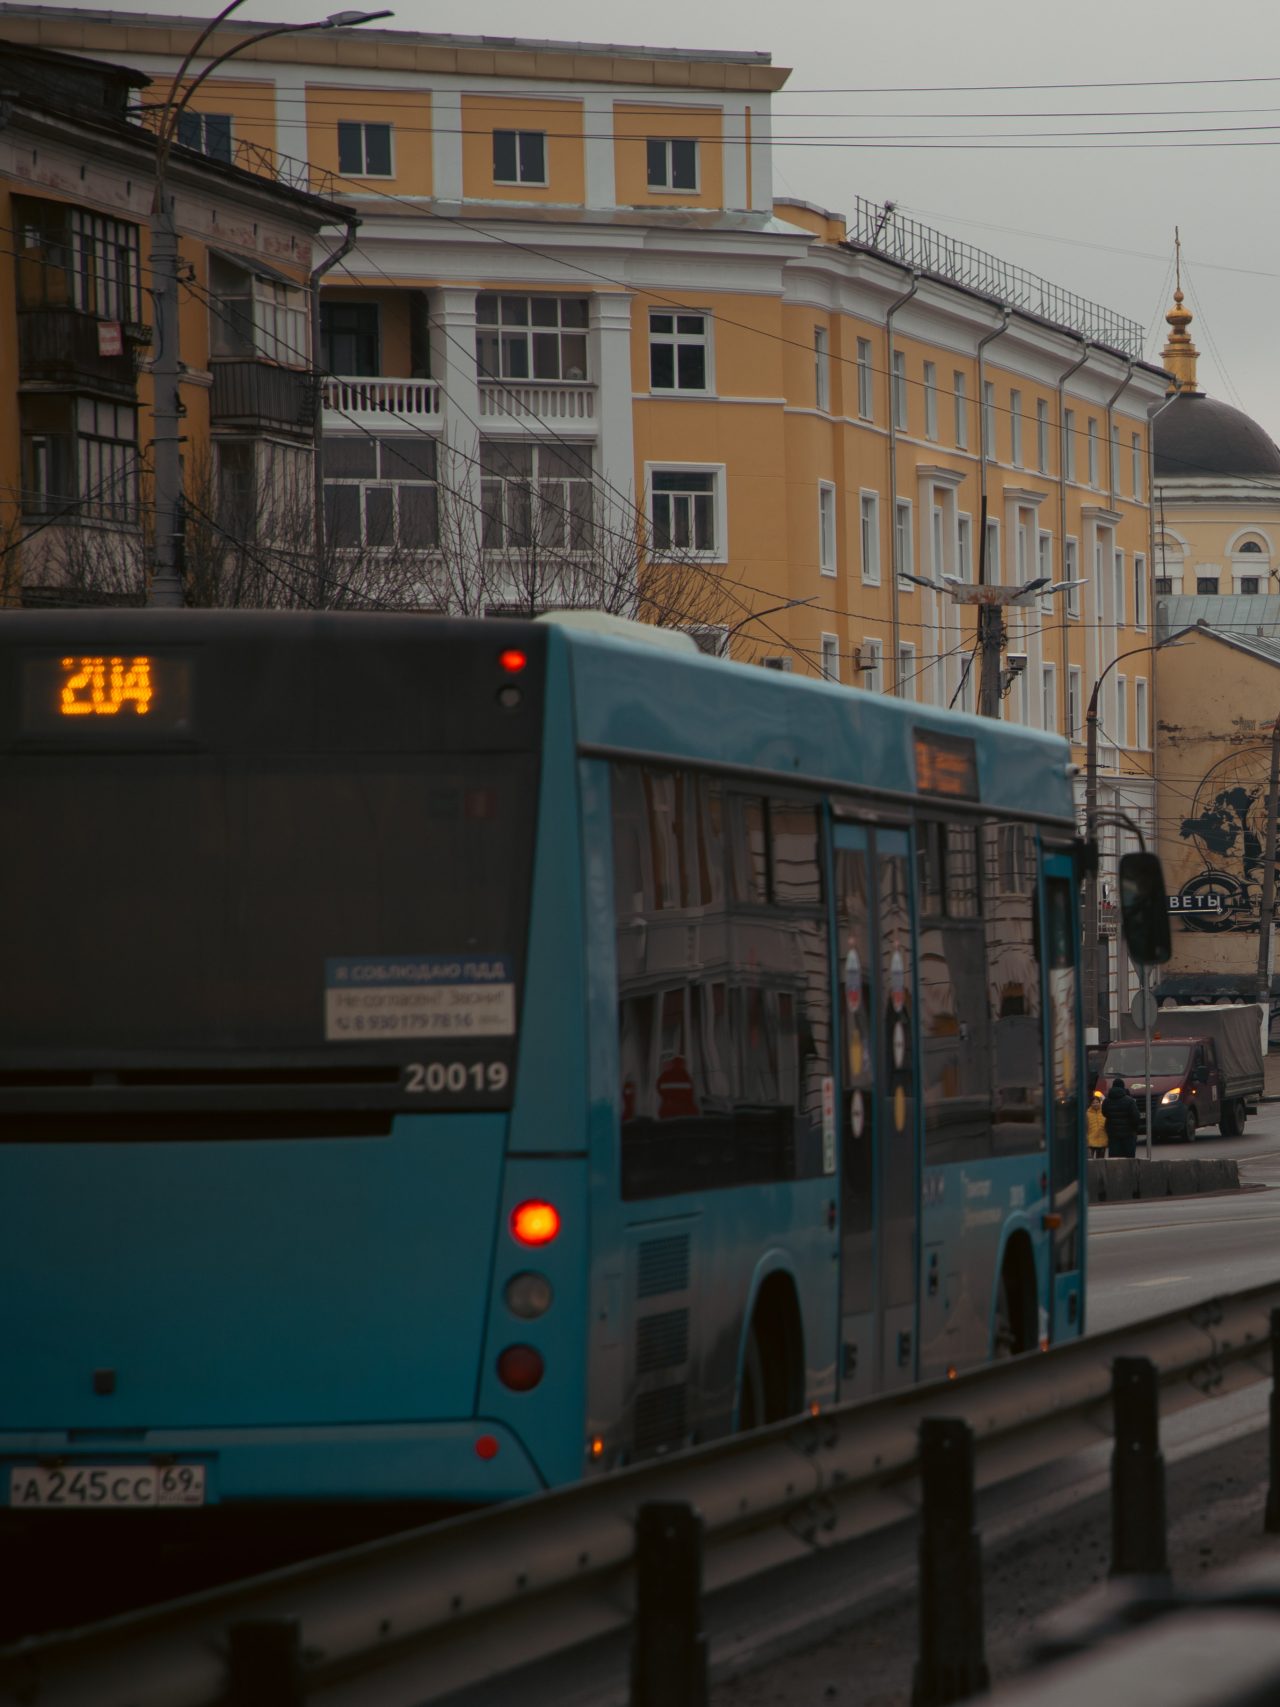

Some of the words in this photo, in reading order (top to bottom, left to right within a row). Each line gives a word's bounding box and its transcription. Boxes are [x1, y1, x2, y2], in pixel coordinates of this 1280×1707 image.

[1169, 896, 1220, 908] ВЕТЫ
[404, 1061, 509, 1092] 20019
[163, 1467, 194, 1492] 69
